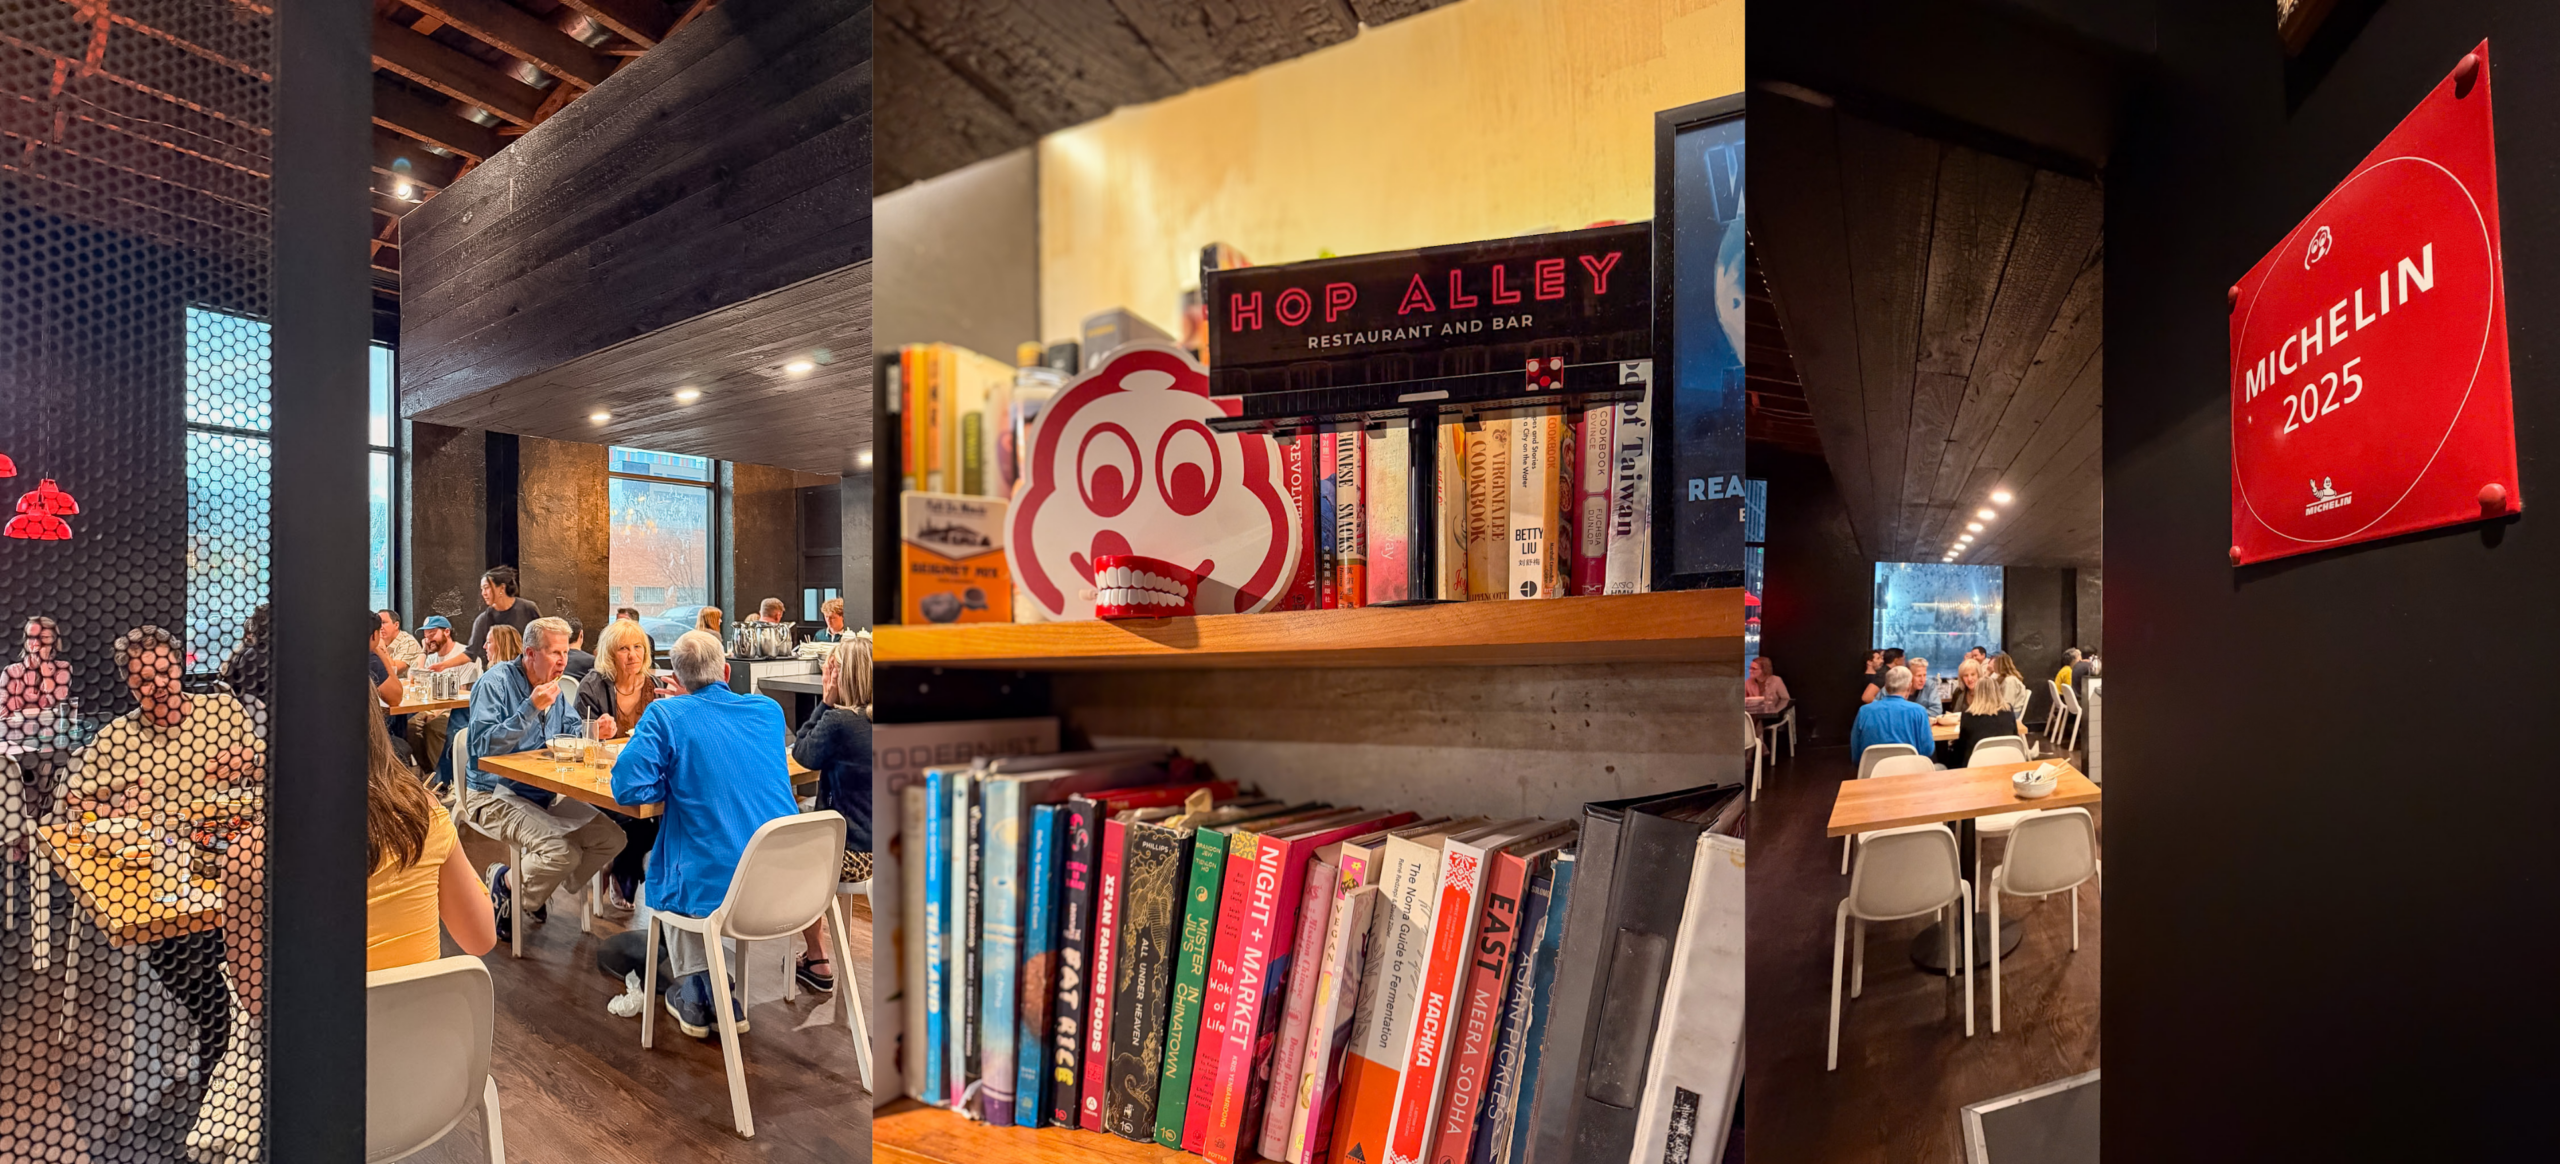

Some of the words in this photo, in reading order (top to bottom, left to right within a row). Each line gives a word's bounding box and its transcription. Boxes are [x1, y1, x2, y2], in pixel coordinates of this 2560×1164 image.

[1231, 281, 1358, 332] HOP
[1397, 251, 1622, 315] ALLEY
[1308, 325, 1433, 349] RESTAURANT
[1440, 318, 1484, 337] AND
[1492, 314, 1533, 331] BAR
[2245, 242, 2434, 403] MICHELIN
[2282, 357, 2363, 435] 2025
[1521, 429, 1530, 442] City
[1522, 444, 1529, 453] on
[1531, 432, 1539, 445] and
[1547, 416, 1556, 469] COOKBOOK
[1597, 411, 1608, 477] COOKBOOK
[1338, 432, 1354, 488] CHINESE
[1521, 467, 1530, 488] Water
[1522, 454, 1530, 466] the
[1531, 446, 1539, 470] Stories
[1470, 440, 1487, 544] COOKBOOK
[1491, 451, 1506, 516] VIRGINIA
[1616, 436, 1644, 538] Taiwan
[2305, 494, 2353, 517] MICHELIN
[1338, 503, 1354, 554] SNACKS
[1491, 518, 1505, 542] LEE
[1515, 527, 1544, 542] BETTY
[1587, 510, 1595, 546] DUNLOP
[1595, 508, 1603, 547] FUCHSIA
[1522, 542, 1537, 555] LIU
[872, 736, 1040, 771] ODERNIST
[1142, 841, 1169, 853] PHILLIPS
[1196, 842, 1221, 854] BRANDON
[1202, 849, 1213, 858] JEW
[1251, 846, 1280, 927] NIGHT
[1392, 874, 1402, 898] Redzepi
[1409, 863, 1421, 884] The
[1400, 887, 1416, 921] Noma
[1140, 938, 1150, 958] ALL
[1183, 913, 1198, 953] JIU'S
[1191, 917, 1209, 977] MISTER
[1251, 928, 1263, 942] +
[1304, 916, 1318, 957] Mission
[1326, 904, 1343, 963] VEGAN
[1395, 923, 1411, 957] Guide
[1477, 894, 1516, 980] EAST
[926, 903, 940, 1014] THAILAND
[1096, 927, 1112, 995] FAMOUS
[1216, 959, 1234, 975] The
[1393, 960, 1404, 972] to
[1059, 946, 1082, 1011] FAT
[1136, 962, 1147, 1000] UNDER
[1187, 985, 1200, 1003] IN
[1297, 959, 1311, 1000] Chinese
[1509, 951, 1533, 1018] ASIAN
[1213, 1001, 1226, 1013] of
[1230, 946, 1262, 1051] MARKET
[1378, 974, 1402, 1050] Fermentation
[1091, 998, 1105, 1053] FOODS
[1132, 1003, 1143, 1047] HEAVEN
[1165, 982, 1188, 1079] CHINATOWN
[1206, 1017, 1225, 1034] Life
[1416, 991, 1445, 1068] KACHKA
[1463, 989, 1490, 1055] MEERA
[1054, 1015, 1078, 1087] RICE
[1229, 1054, 1238, 1073] KRIS
[1285, 1036, 1299, 1070] Danny
[1488, 1026, 1521, 1120] PICKLES
[1447, 1064, 1476, 1134] SODHA
[1207, 1150, 1228, 1162] POTTER
